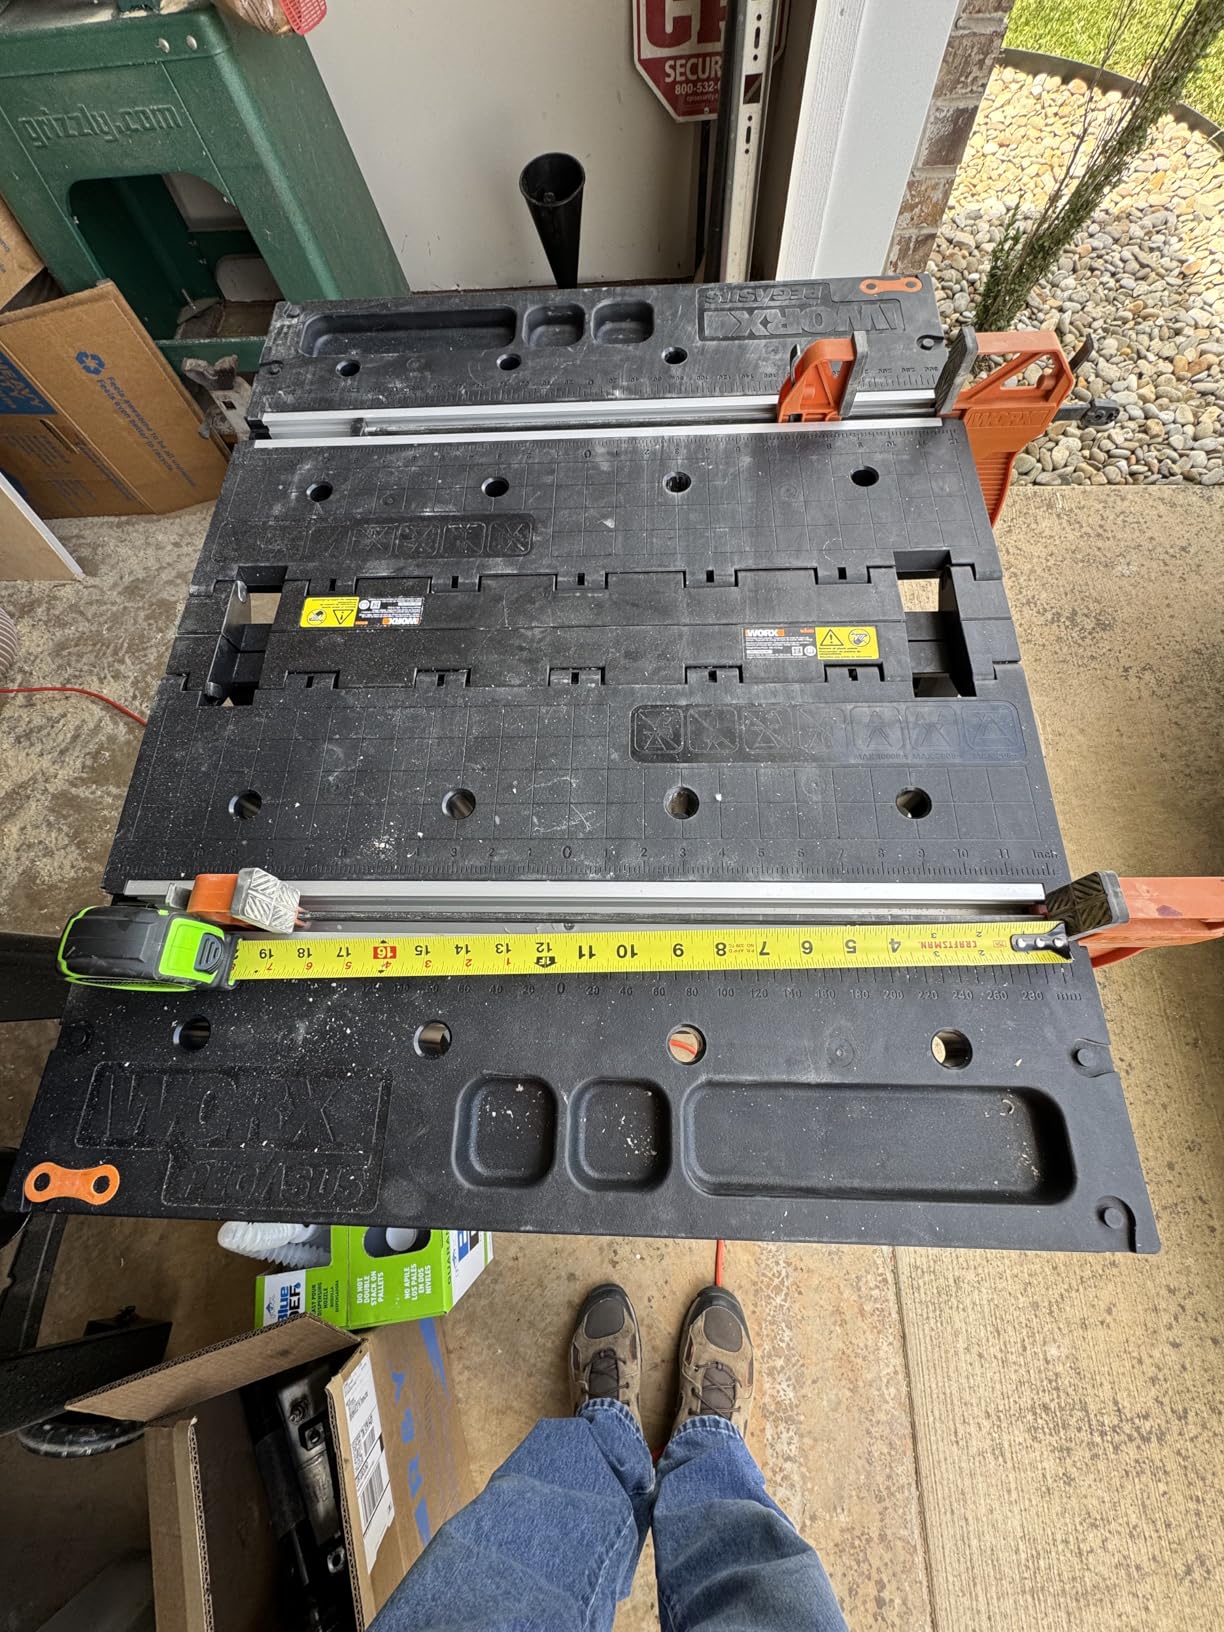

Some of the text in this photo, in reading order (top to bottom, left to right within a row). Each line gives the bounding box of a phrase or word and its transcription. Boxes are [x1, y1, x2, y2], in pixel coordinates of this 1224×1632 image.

[665, 56, 722, 82] SECUR
[675, 80, 720, 95] 800-532-
[18, 104, 183, 147] grizzly.com
[705, 286, 822, 304] PEGASUS
[726, 303, 897, 336] WORX
[746, 629, 778, 637] WORX
[562, 845, 572, 859] 0
[259, 938, 901, 960] 4 5 6 7 8 9 10 11 12 13 14 15 16 17 18 19
[266, 962, 274, 971] 7
[305, 962, 313, 970] 6
[344, 961, 352, 970] 5
[384, 960, 392, 969] 4
[424, 960, 432, 968] 3
[465, 959, 472, 967] 2
[556, 982, 566, 995] 0
[619, 986, 633, 996] 40
[653, 987, 665, 997] 60
[686, 987, 699, 997] 80
[717, 987, 735, 997] 100
[750, 988, 768, 998] 120
[850, 990, 869, 1000] 180
[883, 990, 904, 1000] 200
[918, 990, 939, 1000] 220
[952, 990, 973, 1000] 240
[986, 991, 1008, 1000] 260
[1022, 991, 1044, 1000] 280
[371, 1270, 377, 1281] ON
[424, 1265, 432, 1294] NIVELES
[404, 1289, 411, 1299] NO
[418, 1283, 424, 1294] EN
[278, 1286, 289, 1321] Blue
[357, 1293, 363, 1304] DO
